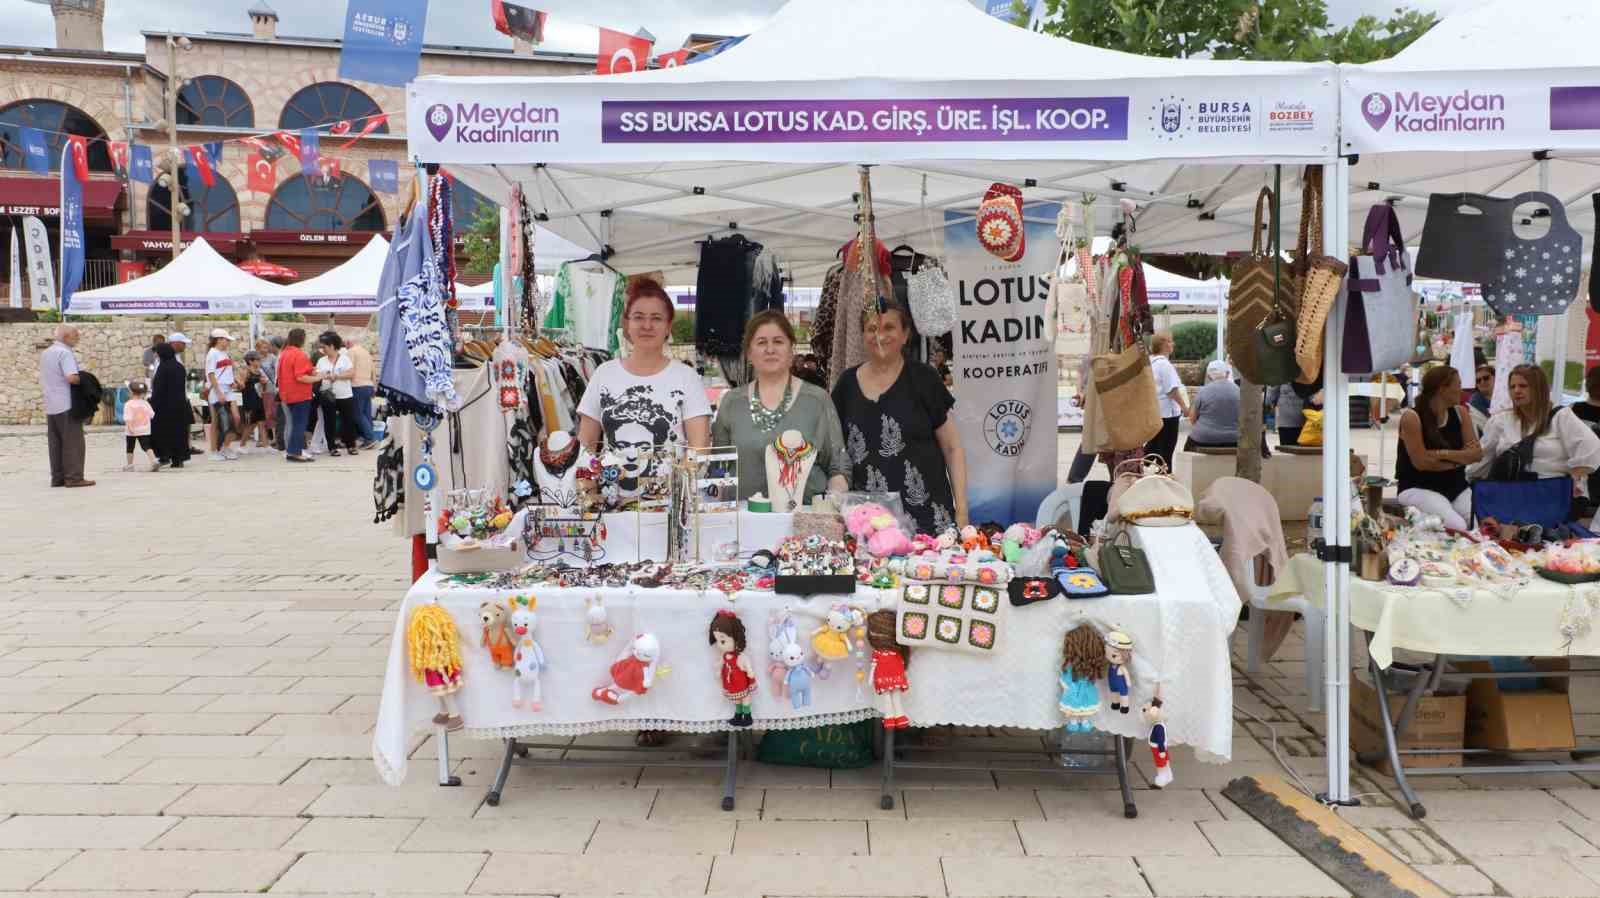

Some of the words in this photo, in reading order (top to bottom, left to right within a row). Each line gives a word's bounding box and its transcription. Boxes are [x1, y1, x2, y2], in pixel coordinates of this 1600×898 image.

[1199, 102, 1251, 113] BURSA
[1395, 90, 1505, 117] Meydan
[456, 102, 559, 130] Meydan
[620, 111, 648, 132] SS
[653, 111, 728, 132] BURSA
[734, 111, 807, 132] LOTUS
[813, 110, 868, 131] KAD.
[872, 105, 932, 136] GİRŞ.
[937, 106, 987, 130] ÜRE.
[992, 105, 1031, 136] İŞL.
[1036, 108, 1109, 130] KOOP.
[1270, 111, 1313, 121] BOZBEY
[1395, 113, 1505, 132] Kadınların
[456, 124, 559, 143] Kadınların
[9, 206, 40, 214] LEZZET
[299, 233, 325, 241] ÖZLEM
[959, 275, 1050, 306] LOTUS
[990, 402, 1030, 420] LOTUS
